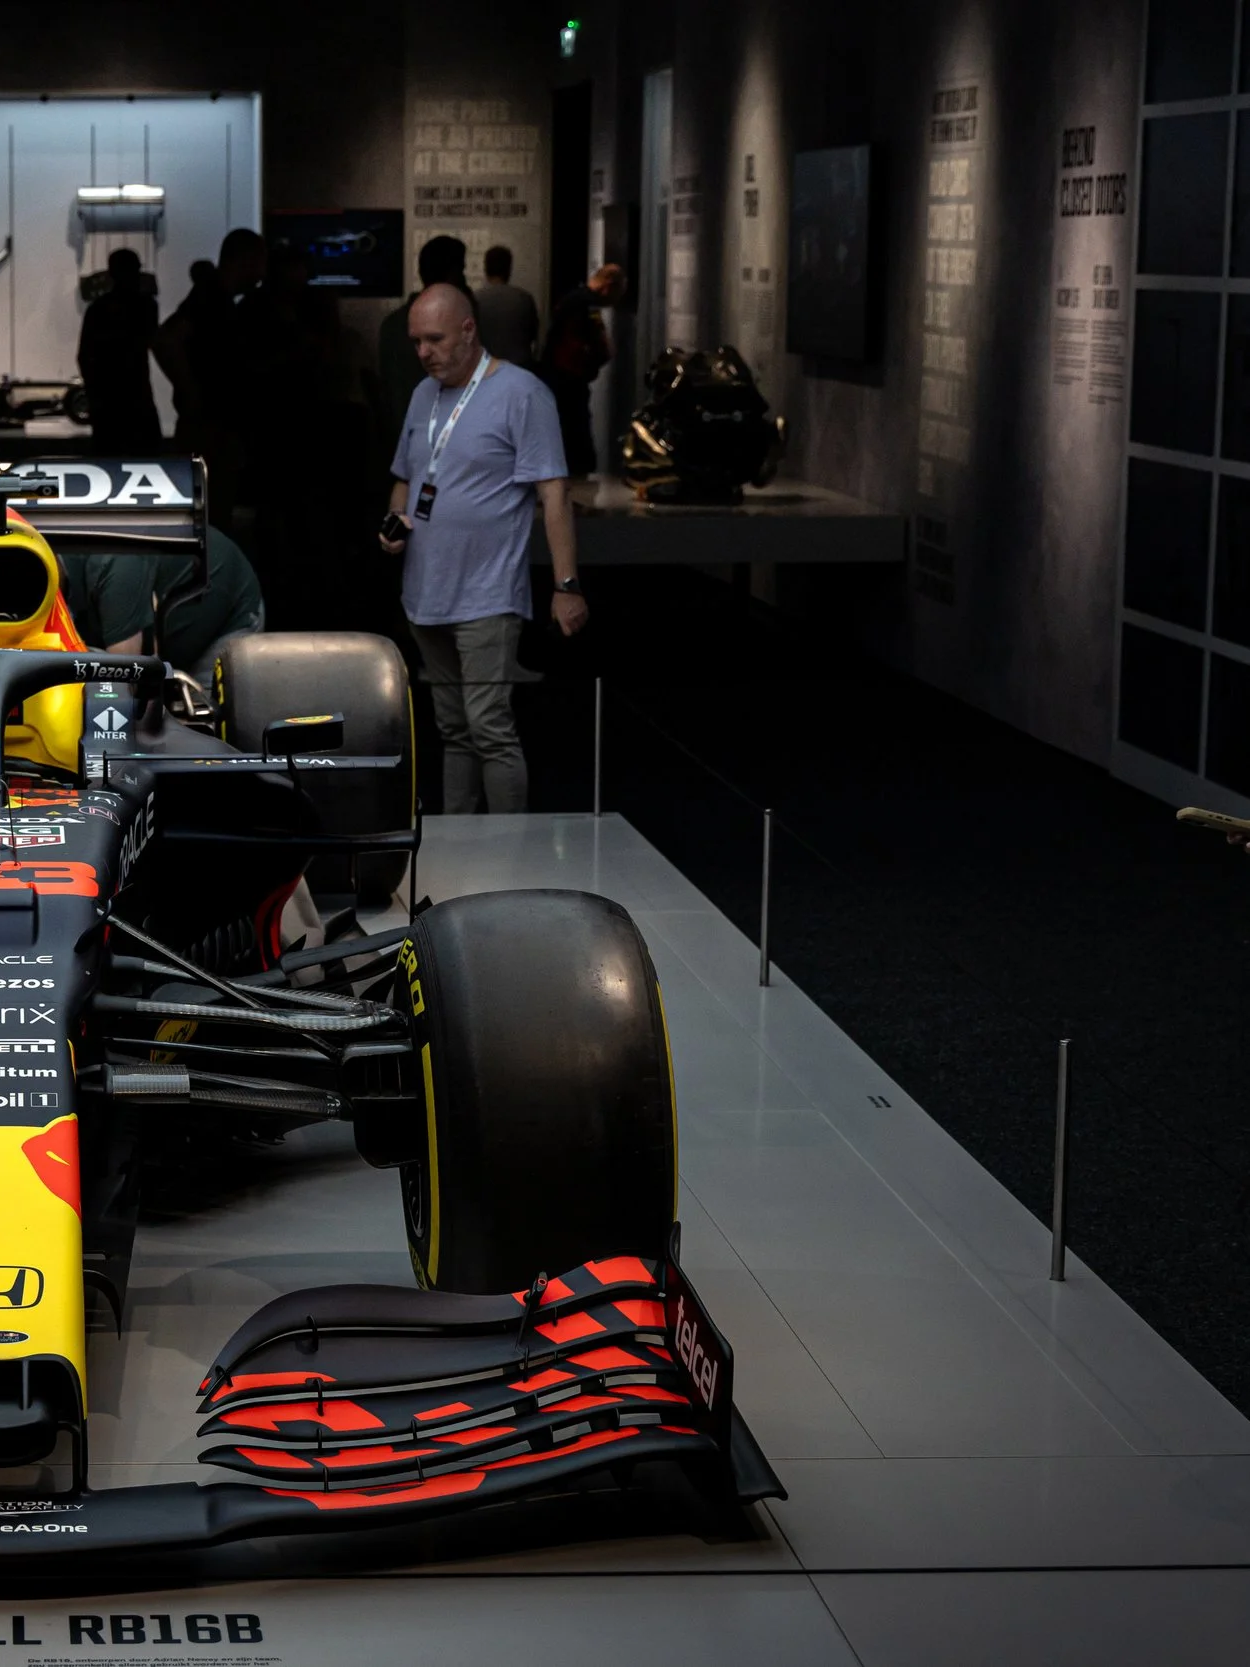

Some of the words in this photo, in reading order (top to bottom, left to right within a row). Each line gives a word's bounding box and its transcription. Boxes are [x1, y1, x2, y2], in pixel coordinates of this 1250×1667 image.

[1061, 176, 1093, 217] CLOSED
[1096, 173, 1127, 215] DOORS
[90, 661, 131, 679] Tezos
[93, 731, 127, 740] INTER
[674, 1293, 719, 1412] telcel
[69, 1614, 263, 1645] RB16B
